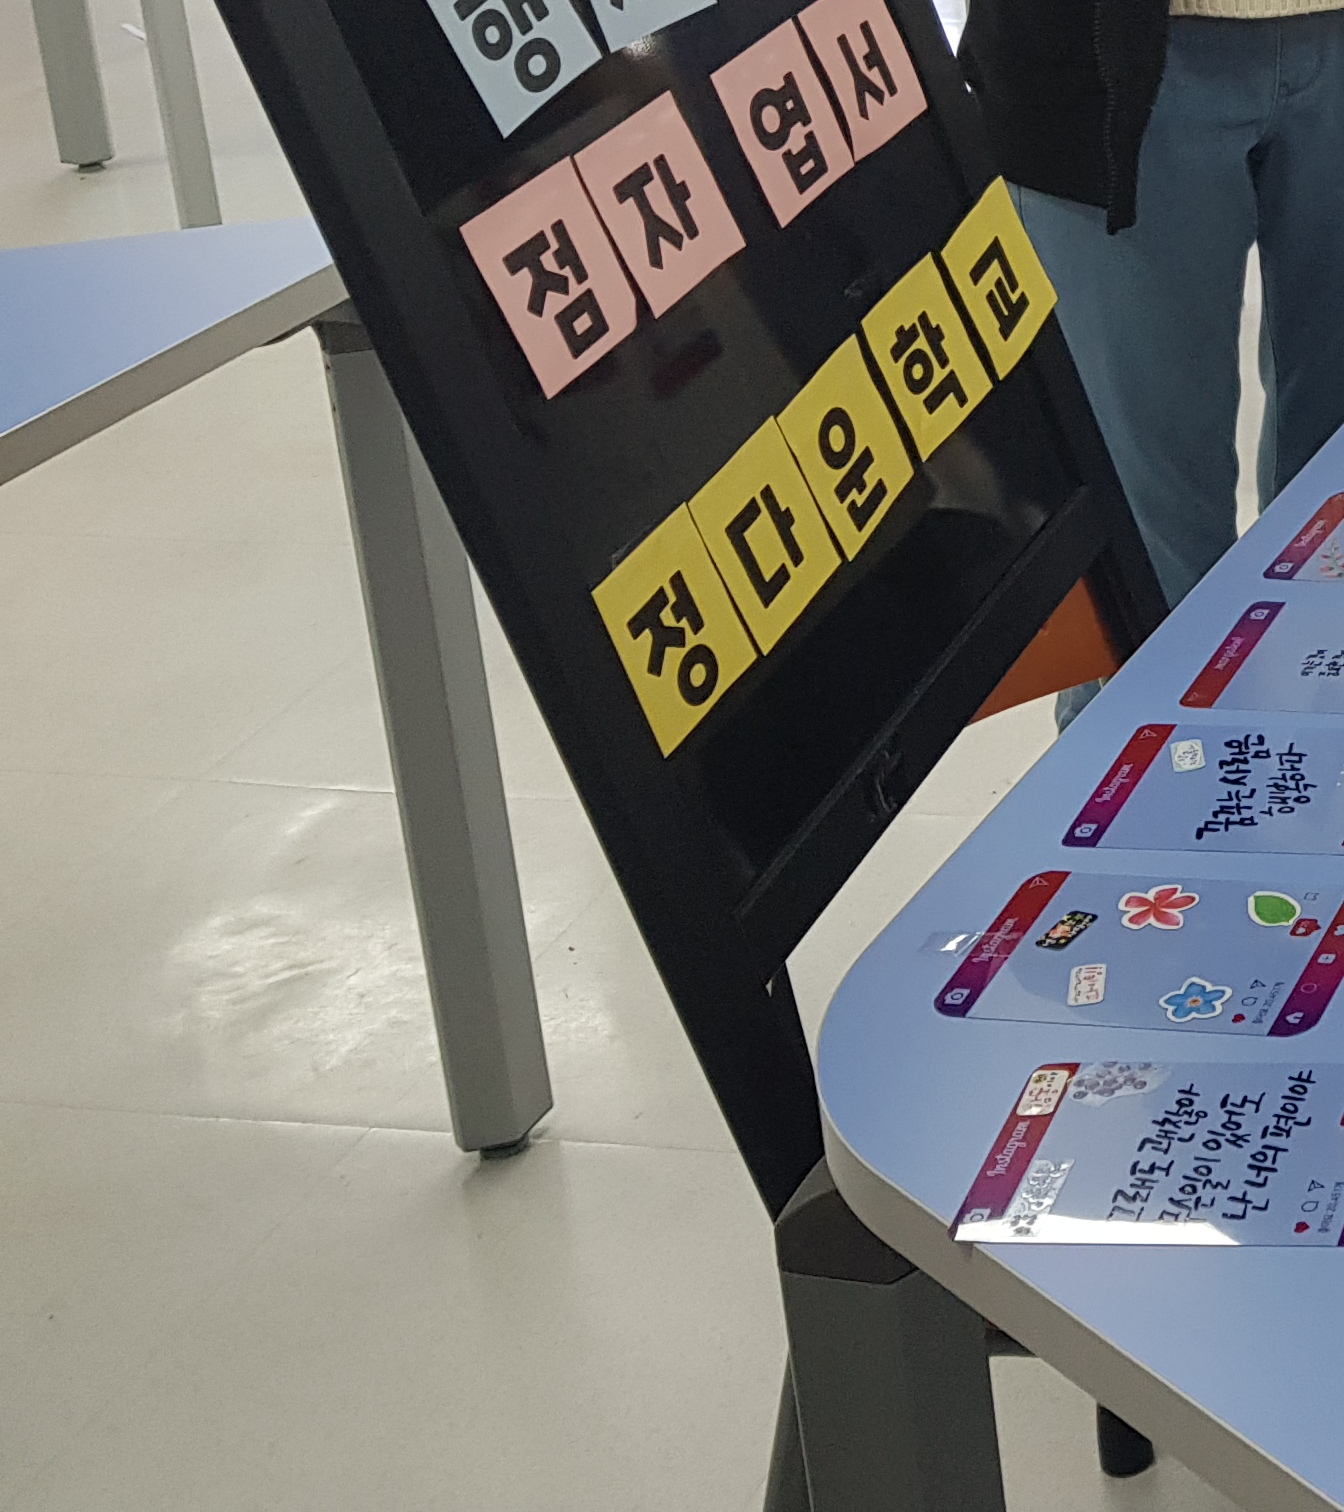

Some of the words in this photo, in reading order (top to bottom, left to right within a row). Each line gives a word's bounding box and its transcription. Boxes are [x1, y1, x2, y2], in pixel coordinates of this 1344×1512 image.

[503, 154, 700, 360] 점자
[749, 20, 898, 196] 엽서
[1218, 734, 1271, 787] 사람은
[1258, 742, 1317, 817] 행복하다
[1194, 788, 1258, 841] 꿈꾸는
[1137, 1083, 1208, 1155] 괜찮아
[1201, 1092, 1266, 1151] 있어도
[1261, 1069, 1315, 1138] 편이야
[987, 1118, 1031, 1177] Instagram
[1244, 1144, 1287, 1188] 너의
[1106, 1160, 1174, 1222] 그래도
[1222, 1190, 1270, 1221] 난
